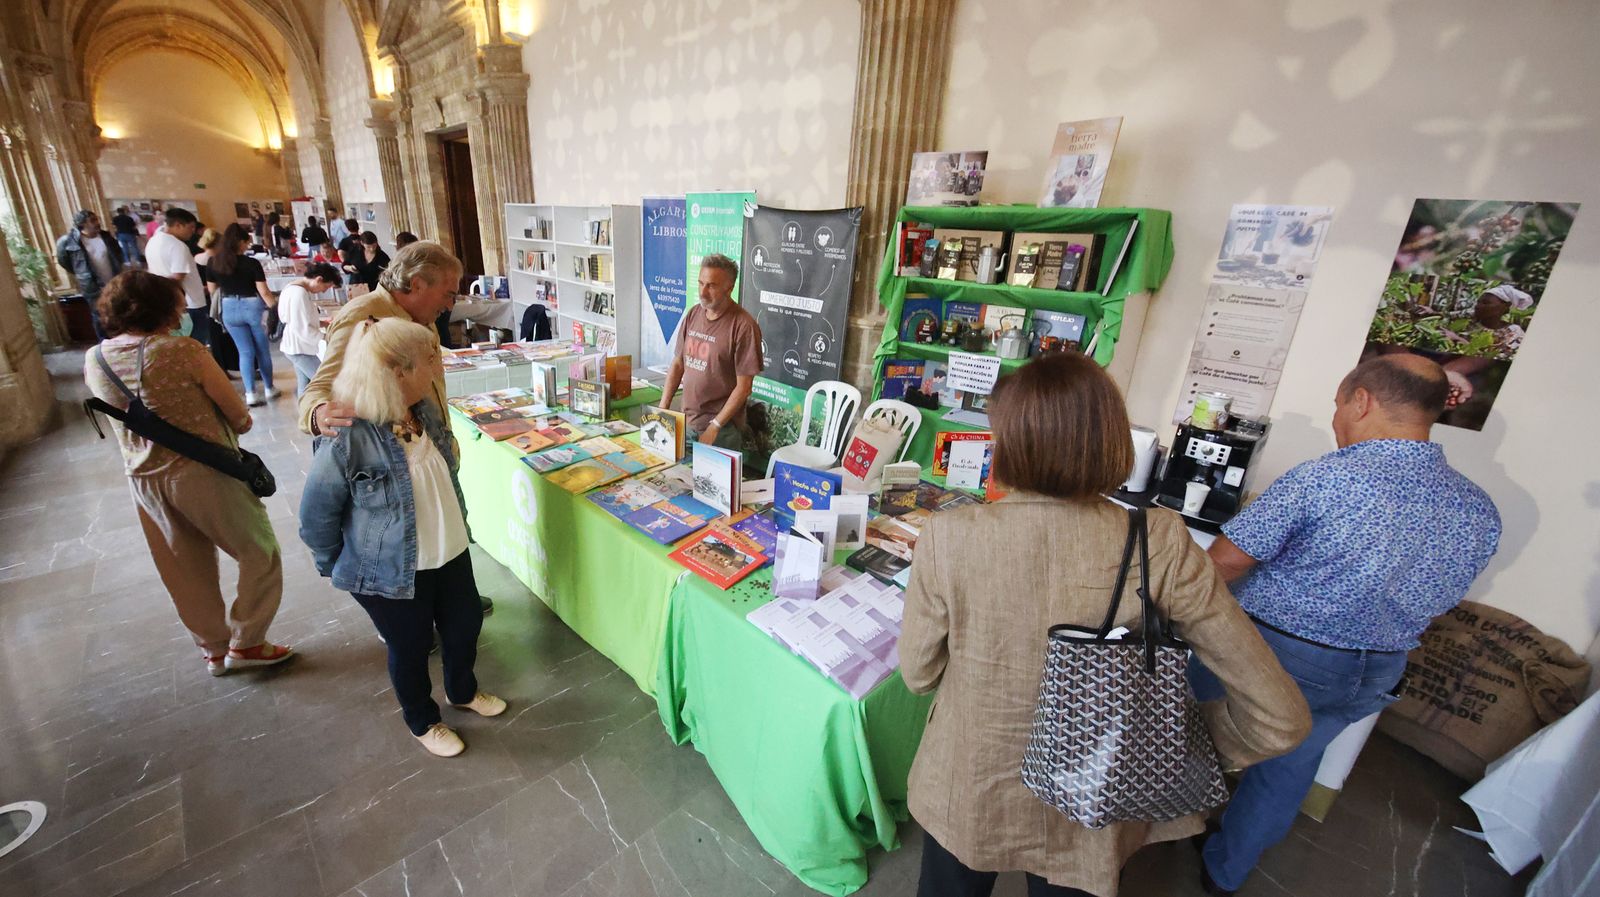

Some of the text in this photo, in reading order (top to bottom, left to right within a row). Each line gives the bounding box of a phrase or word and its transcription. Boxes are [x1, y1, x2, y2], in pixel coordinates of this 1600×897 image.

[653, 226, 687, 238] LIBROS
[690, 238, 742, 256] UN FUTURO
[819, 488, 828, 497] luz
[1446, 606, 1478, 627] FOR
